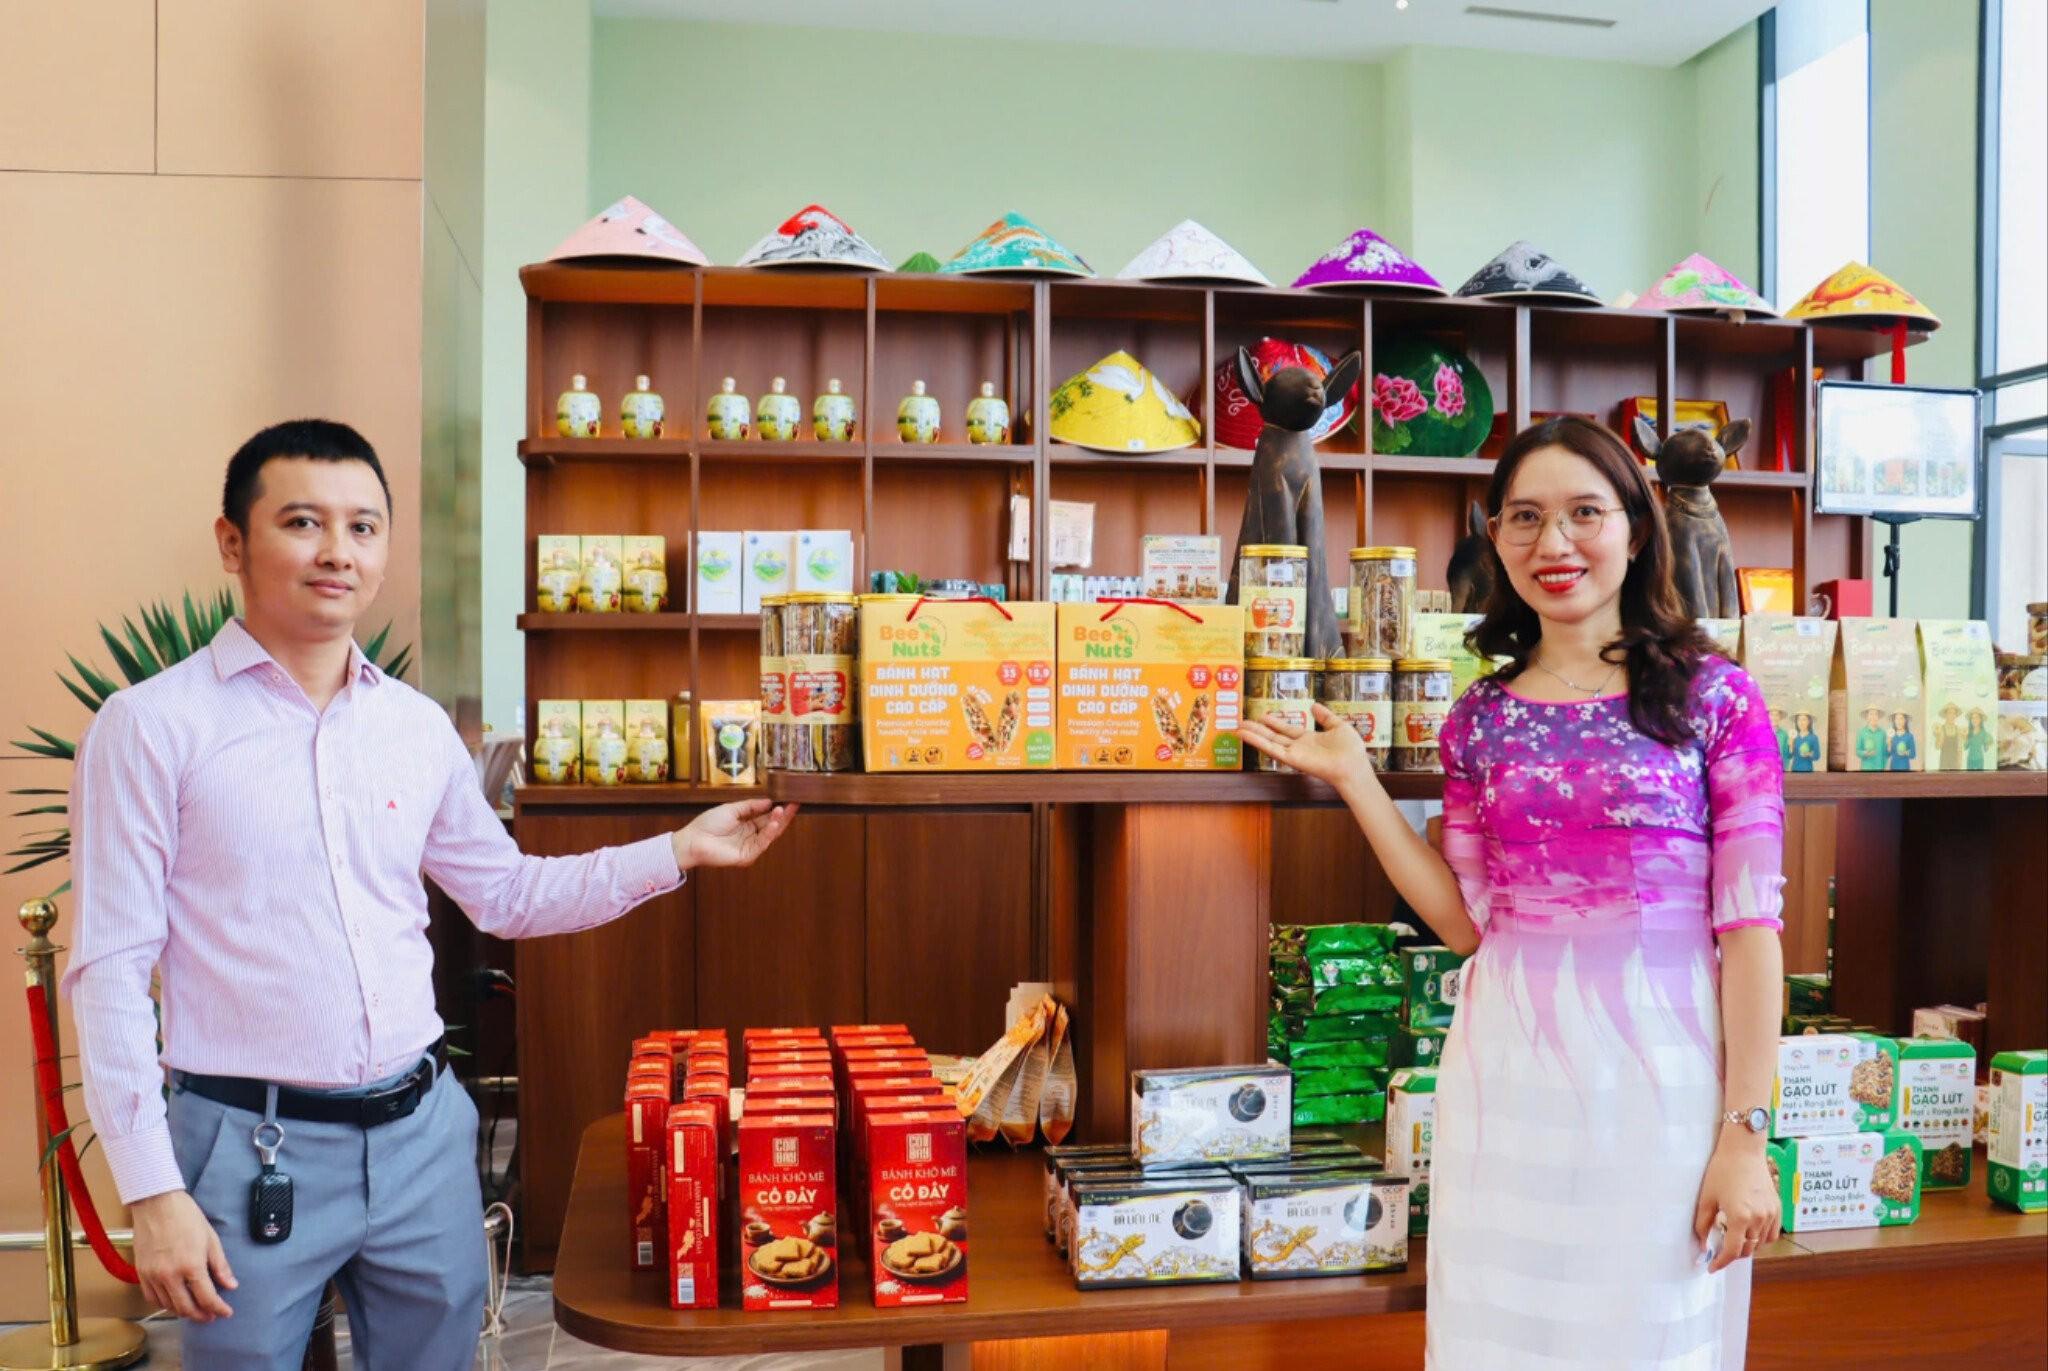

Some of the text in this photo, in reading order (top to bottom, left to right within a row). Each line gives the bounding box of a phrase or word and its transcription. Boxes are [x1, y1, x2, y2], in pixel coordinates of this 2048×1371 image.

[879, 625, 919, 641] Bee
[1073, 626, 1112, 641] Bee
[892, 641, 941, 657] Nuts
[1085, 643, 1133, 658] Nuts
[1783, 1085, 1812, 1099] GẠO
[1803, 1180, 1833, 1194] GẠO
